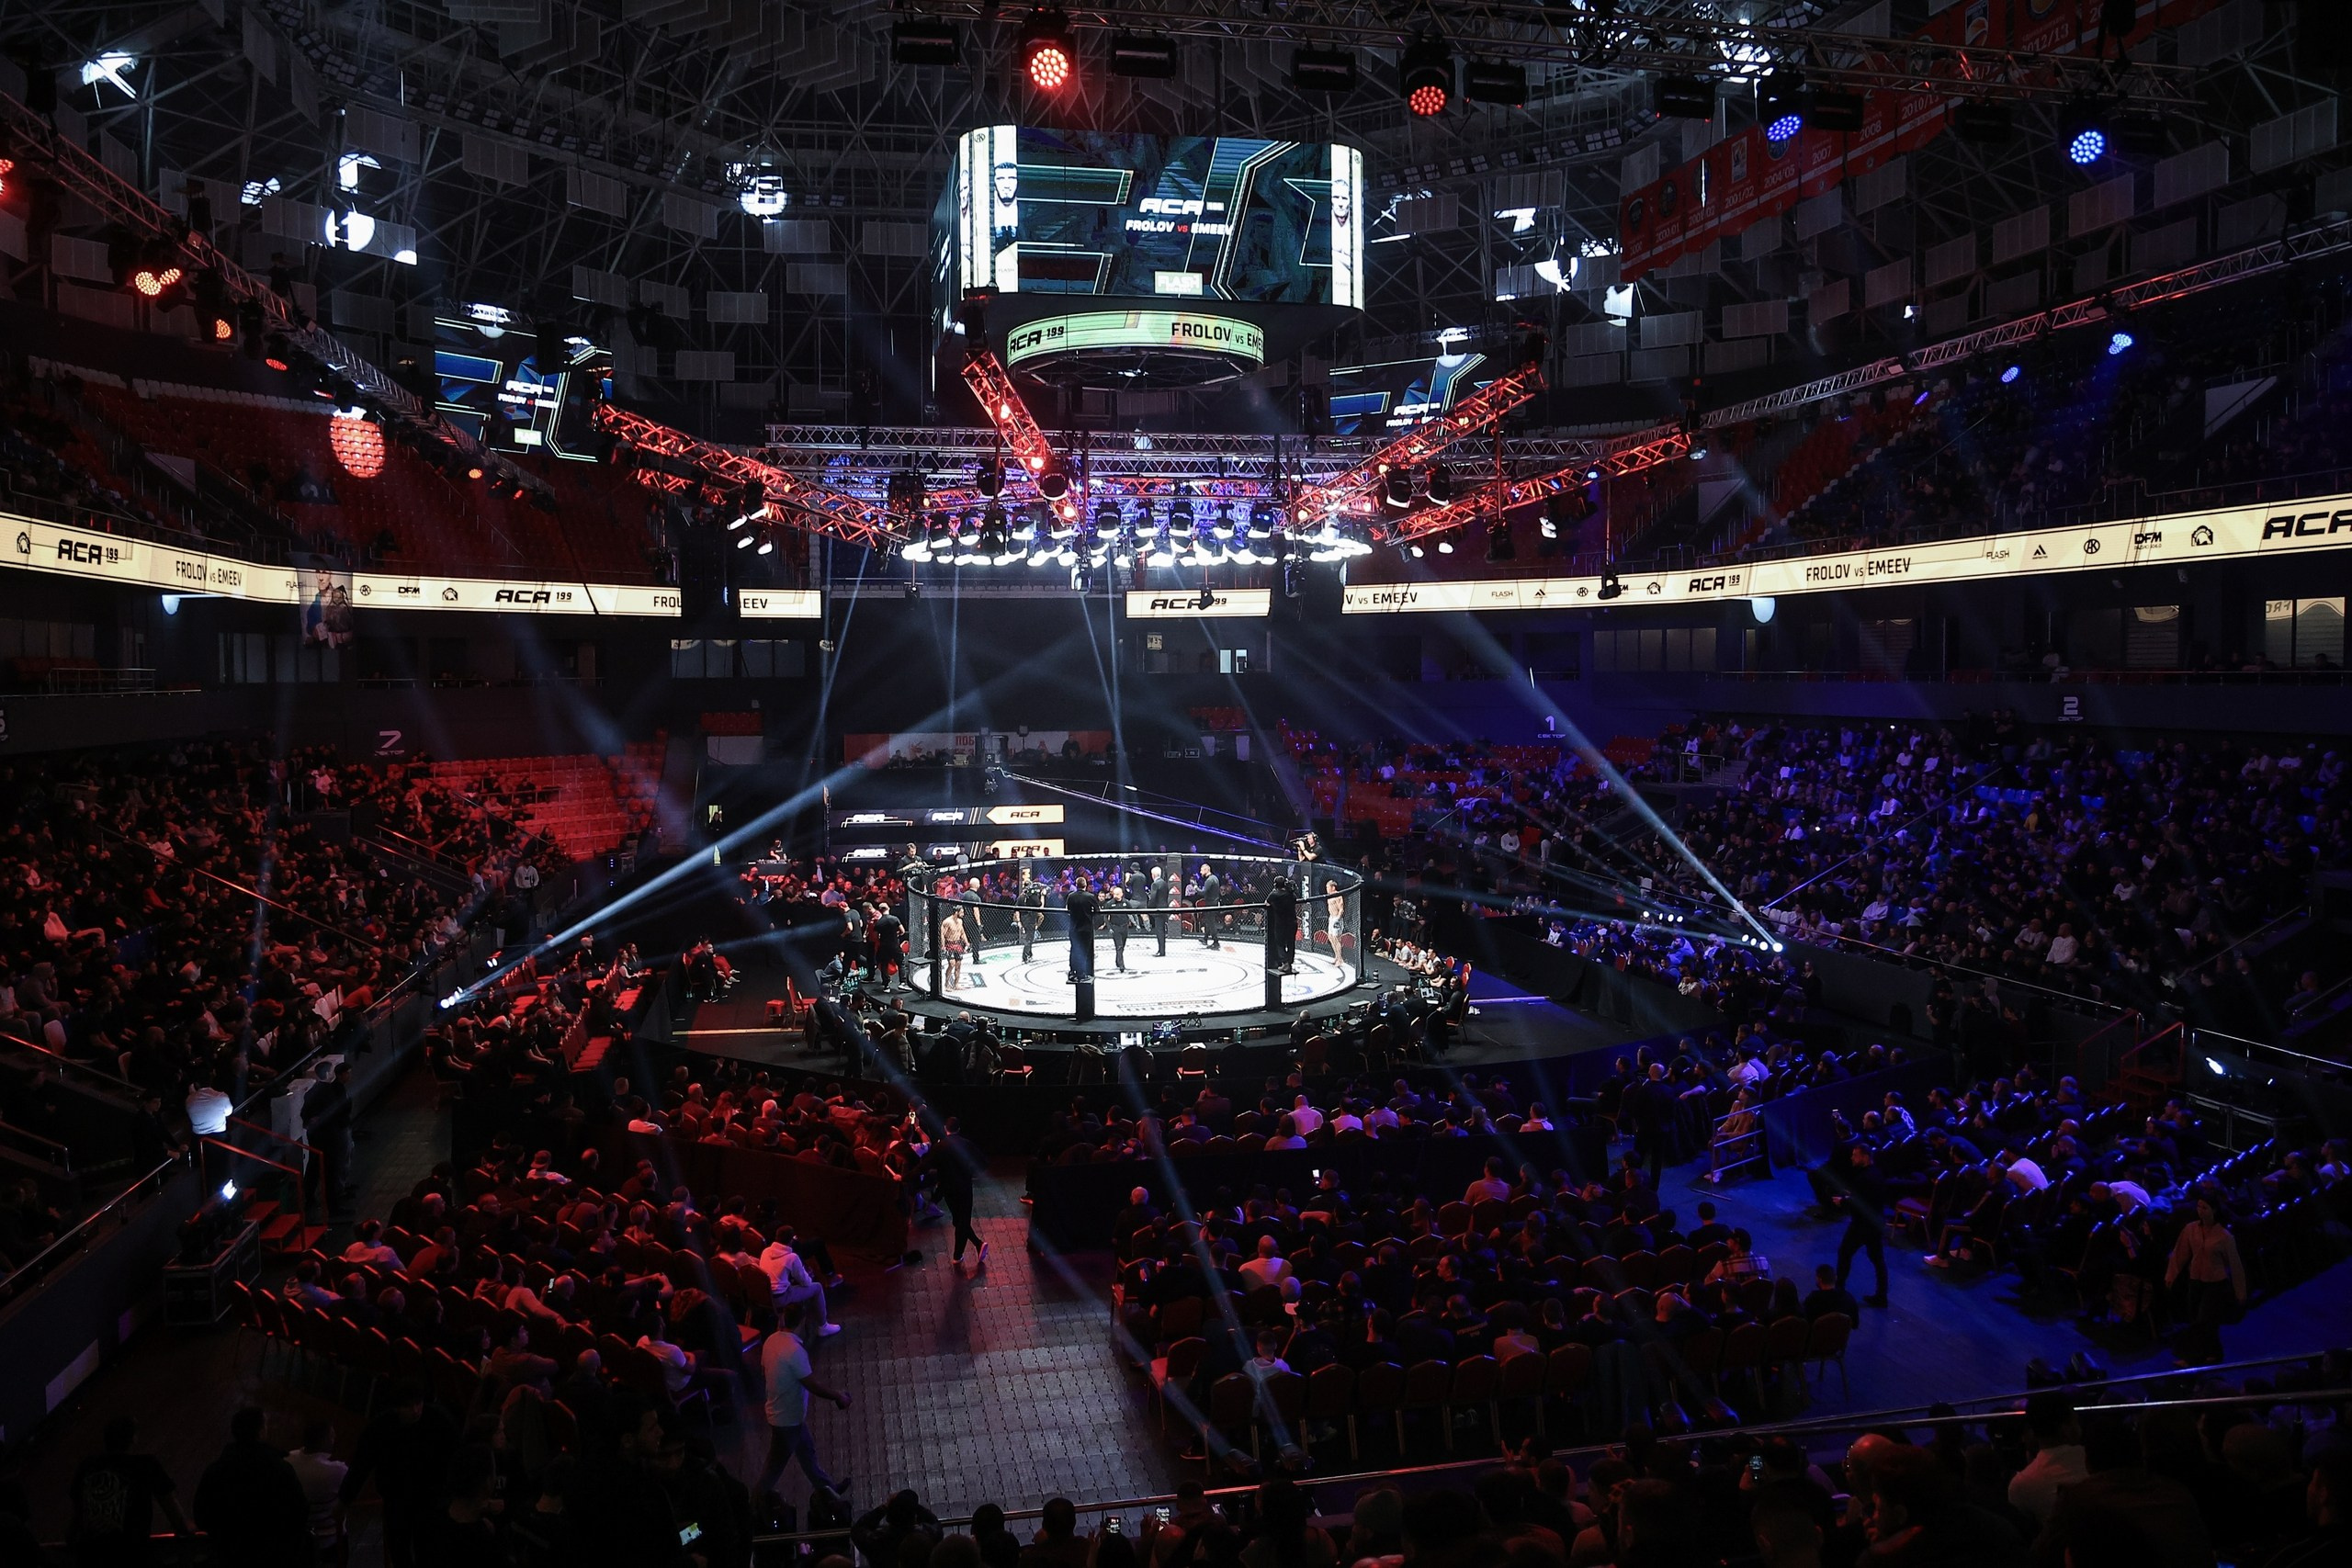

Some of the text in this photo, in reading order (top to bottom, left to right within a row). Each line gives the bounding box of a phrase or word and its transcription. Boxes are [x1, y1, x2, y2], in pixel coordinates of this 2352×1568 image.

[1860, 120, 1882, 141] 2008
[1812, 145, 1832, 165] 2007
[1764, 164, 1795, 189] 2004/05
[1139, 197, 1204, 215] ACA
[1725, 186, 1755, 209] 2001/02
[1125, 220, 1174, 232] FROLOV
[1191, 222, 1233, 235] EMEEV
[1010, 330, 1042, 355] ACA
[1046, 326, 1064, 338] 199
[1171, 322, 1231, 342] FROLOV
[1247, 333, 1263, 353] EME
[1393, 402, 1430, 415] ACA
[2262, 509, 2352, 540] ACA
[2135, 532, 2162, 544] DFM
[58, 538, 118, 566] ACA 199
[1986, 549, 2009, 559] FLASH
[175, 560, 208, 581] FROLOV
[217, 568, 243, 587] EMEEV
[1806, 563, 1850, 581] FROLOV
[1868, 557, 1911, 576] EMEEV
[1689, 574, 1740, 593] ACA 199
[495, 590, 571, 604] ACA 199
[741, 598, 768, 608] EEV
[1346, 593, 1353, 604] V
[1373, 592, 1417, 604] EMEEV
[2064, 696, 2078, 715] 2
[1545, 716, 1555, 731] 1
[379, 730, 401, 748] 7
[932, 812, 964, 821] ACA
